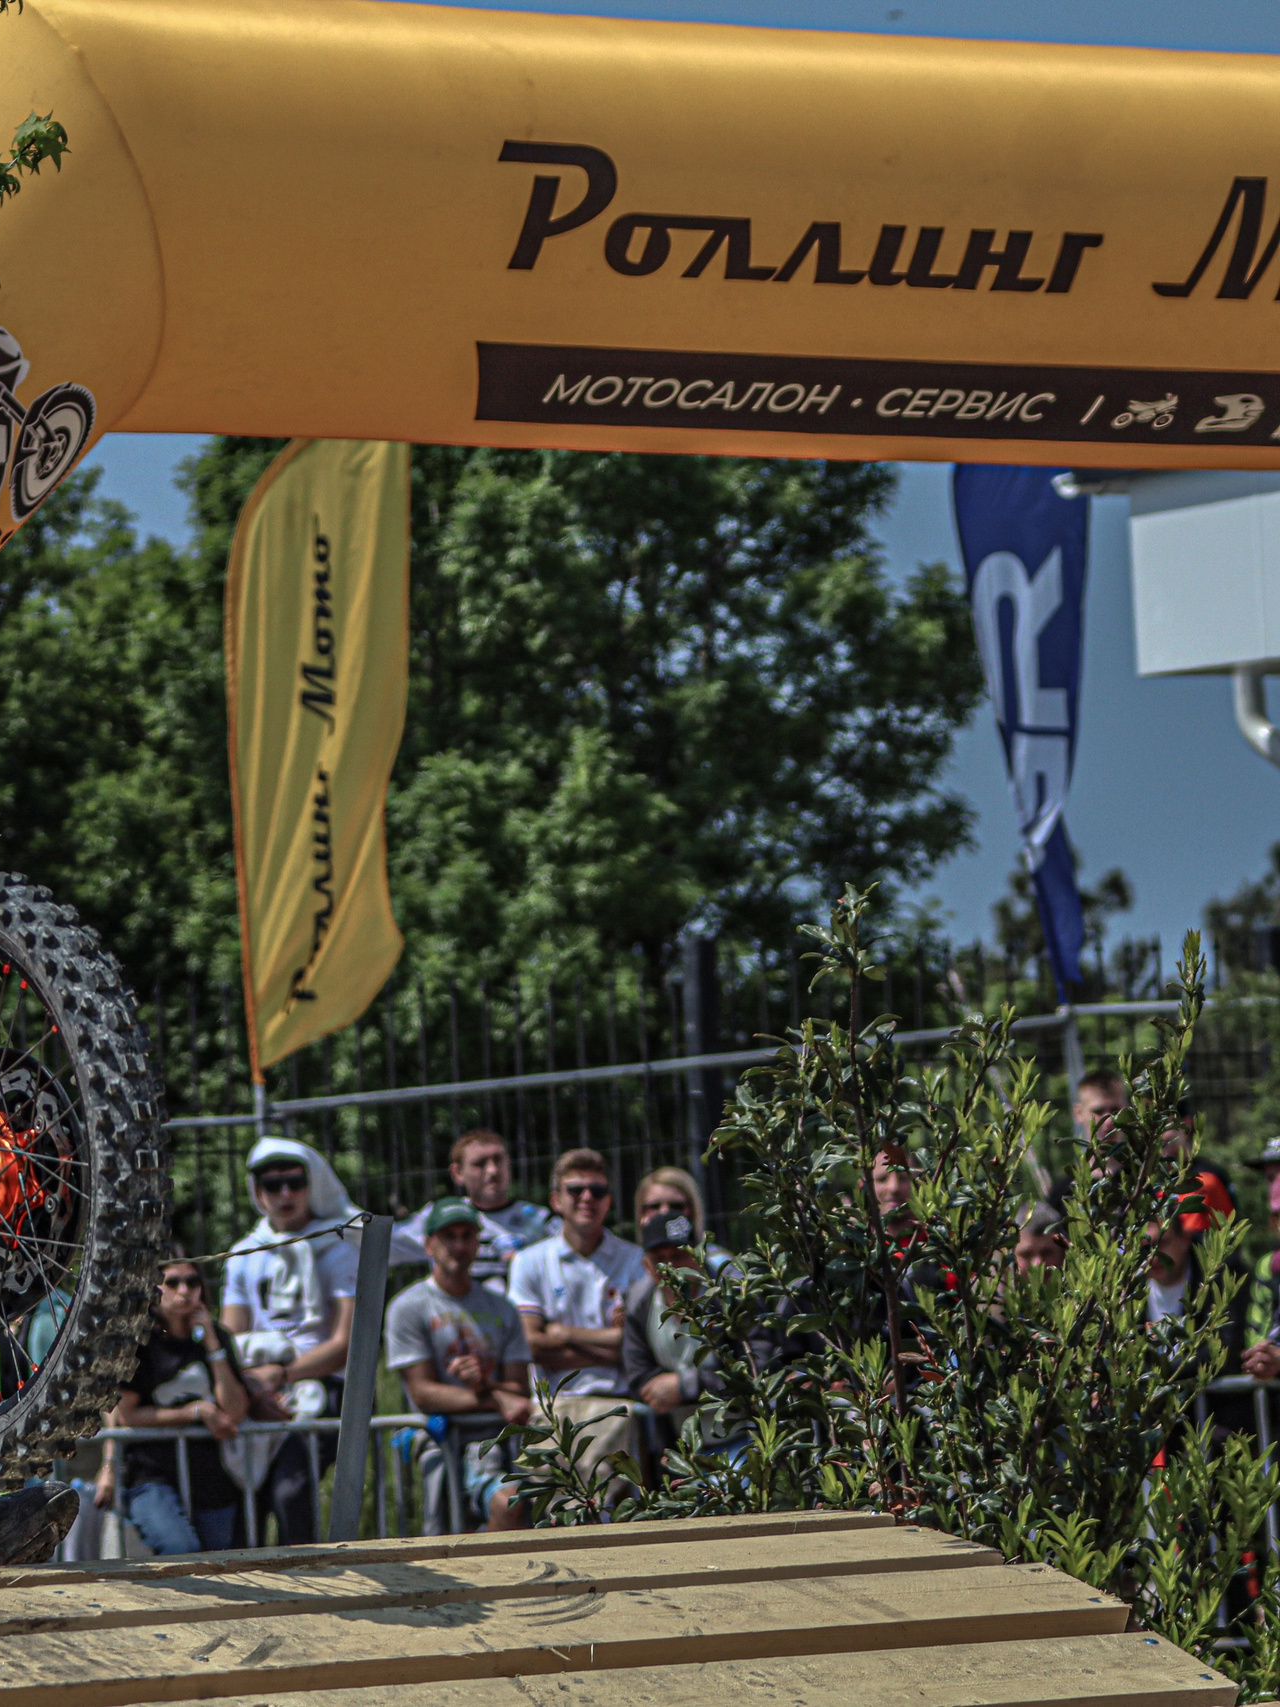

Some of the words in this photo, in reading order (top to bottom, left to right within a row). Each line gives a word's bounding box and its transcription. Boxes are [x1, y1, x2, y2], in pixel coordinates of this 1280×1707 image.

[497, 139, 1105, 294] Роллинг
[541, 372, 843, 417] МОТОСАЛОН
[875, 386, 1058, 424] СЕРВИС
